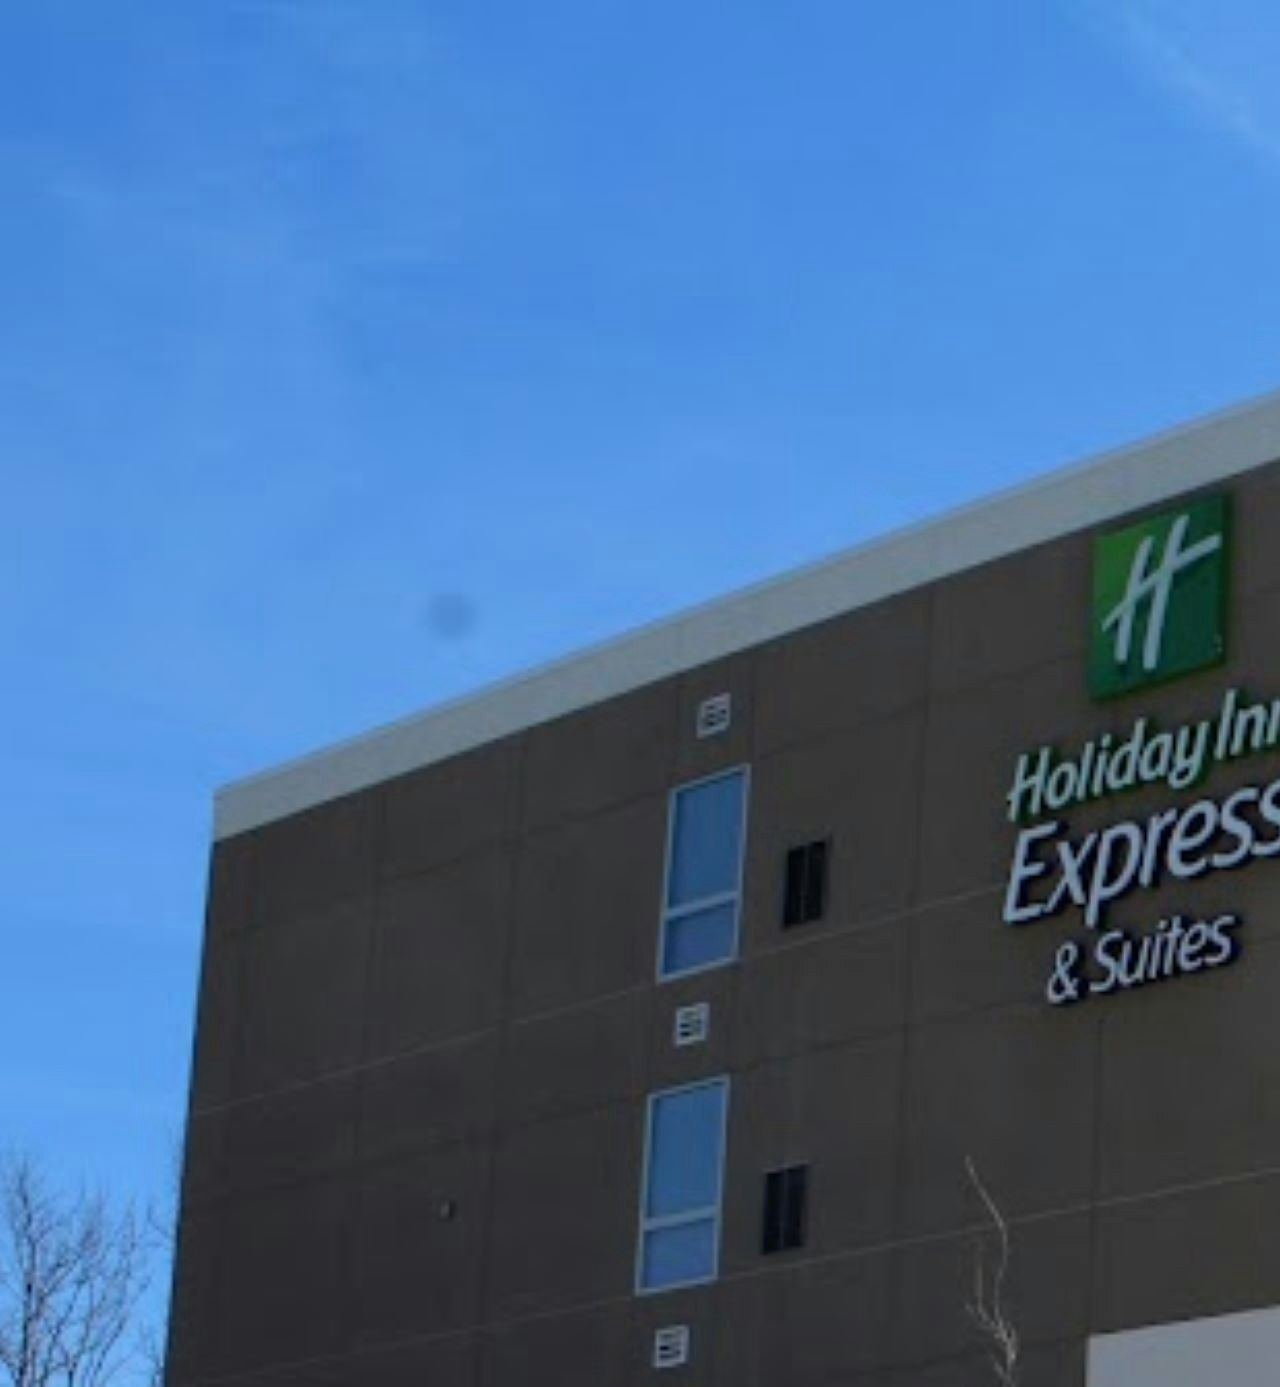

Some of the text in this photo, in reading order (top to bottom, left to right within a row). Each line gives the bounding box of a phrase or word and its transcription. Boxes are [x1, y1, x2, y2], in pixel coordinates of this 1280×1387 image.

[1103, 515, 1222, 670] H
[1008, 717, 1209, 821] Holiday
[1046, 914, 1235, 1003] & Suites
